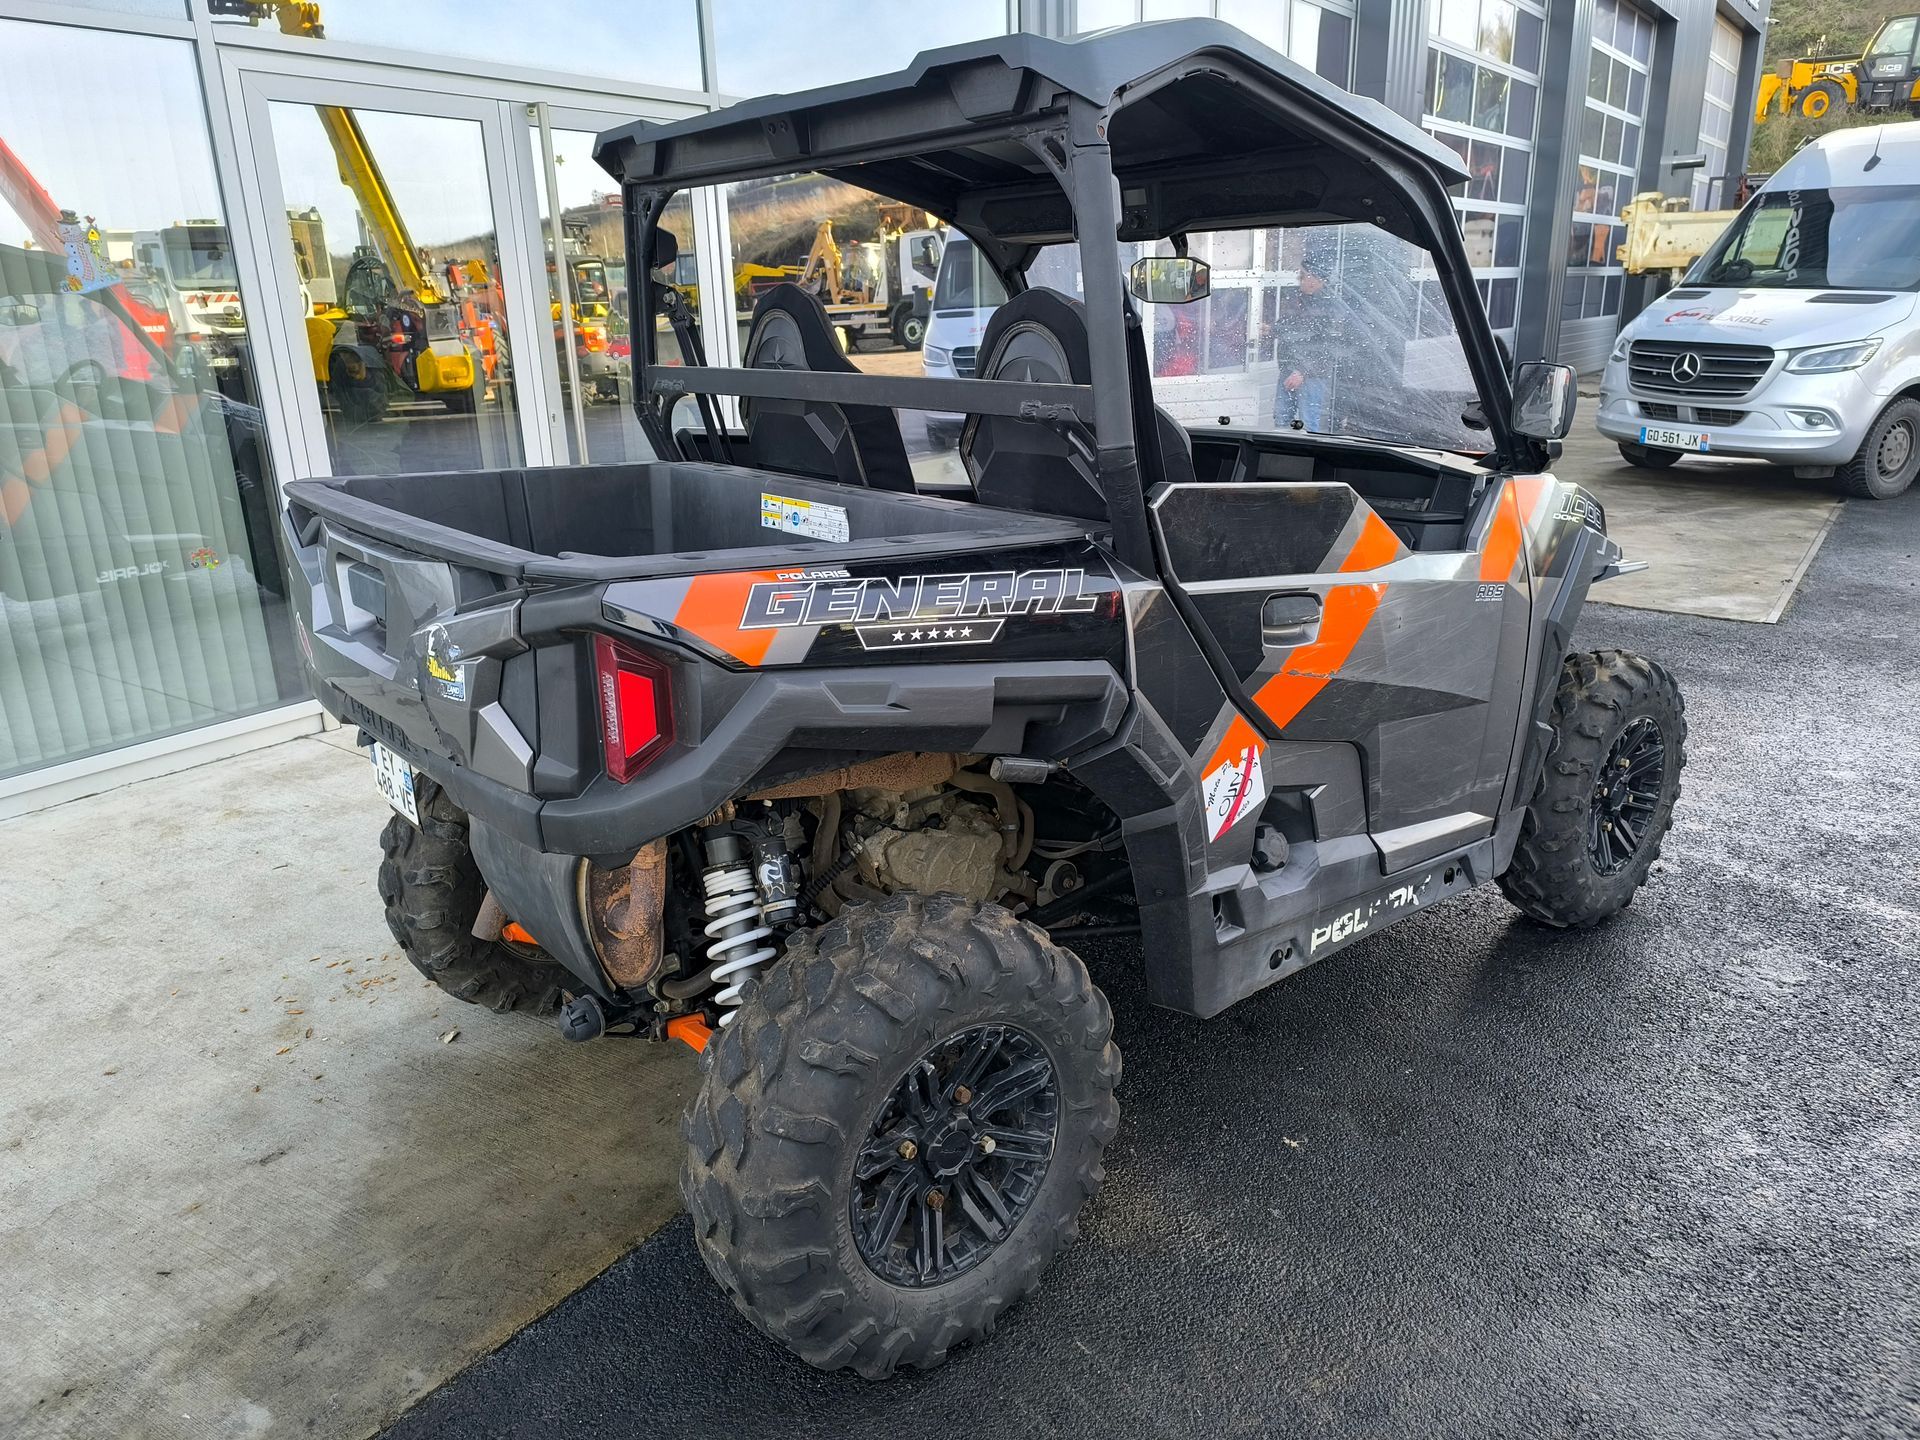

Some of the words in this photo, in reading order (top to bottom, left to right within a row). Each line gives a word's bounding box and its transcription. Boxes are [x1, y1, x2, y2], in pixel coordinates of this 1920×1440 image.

[1879, 63, 1903, 72] JCB
[776, 570, 850, 581] POLARIS
[1476, 584, 1505, 598] ABS
[739, 568, 1098, 629] GENERAL
